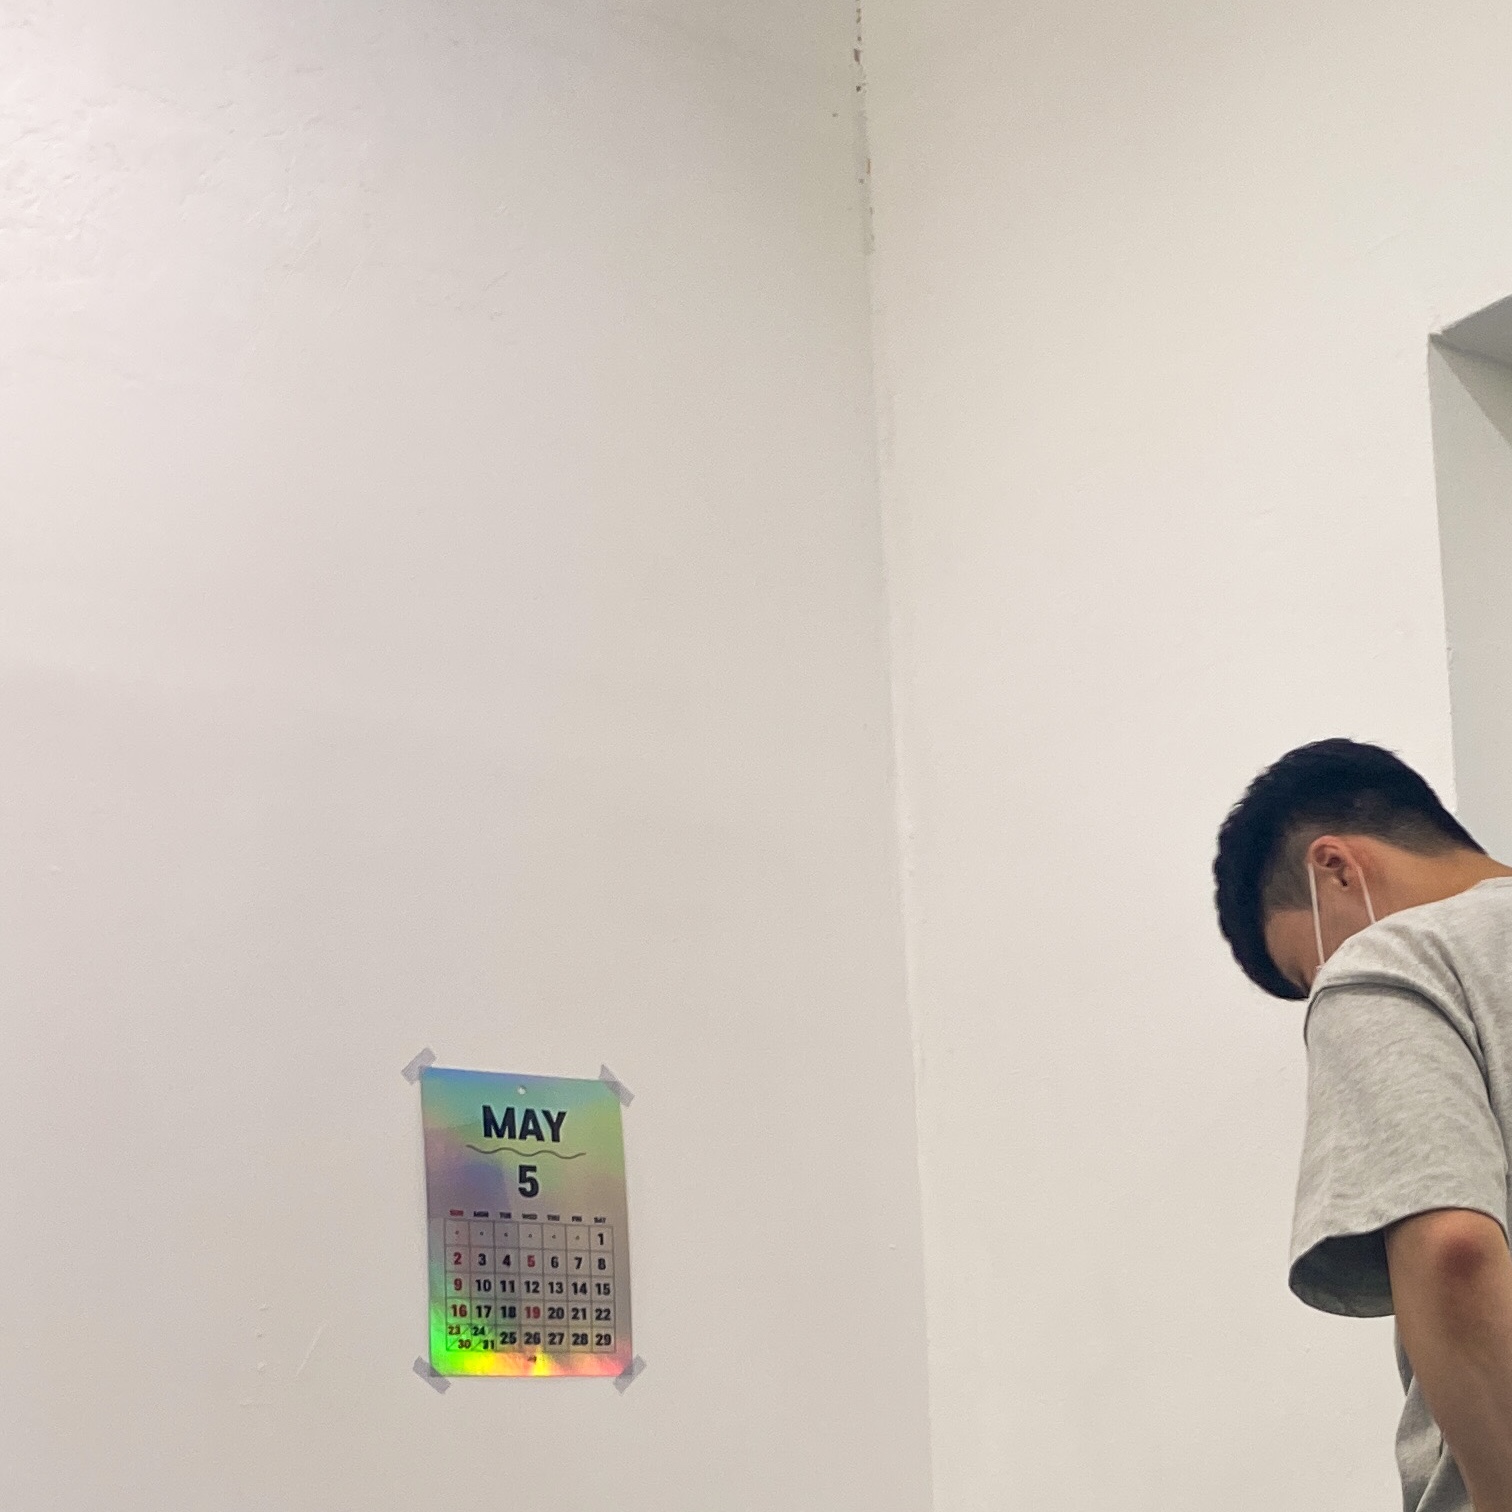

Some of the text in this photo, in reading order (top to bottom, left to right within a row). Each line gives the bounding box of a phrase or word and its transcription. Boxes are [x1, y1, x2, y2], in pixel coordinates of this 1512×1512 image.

[481, 1105, 568, 1143] MAY
[518, 1164, 540, 1199] 5
[597, 1233, 604, 1246] 1
[453, 1252, 606, 1271] 2 3 4 5 6 7 8
[454, 1278, 611, 1296] 9 10 11 12 13 14 15
[451, 1304, 611, 1321] 16 17 18 19 20 21 22
[458, 1339, 472, 1349] 30
[473, 1326, 485, 1336] 24
[500, 1332, 517, 1345] 25
[524, 1332, 541, 1345] 26
[548, 1333, 565, 1345] 27
[572, 1333, 588, 1346] 28
[595, 1334, 611, 1346] 29
